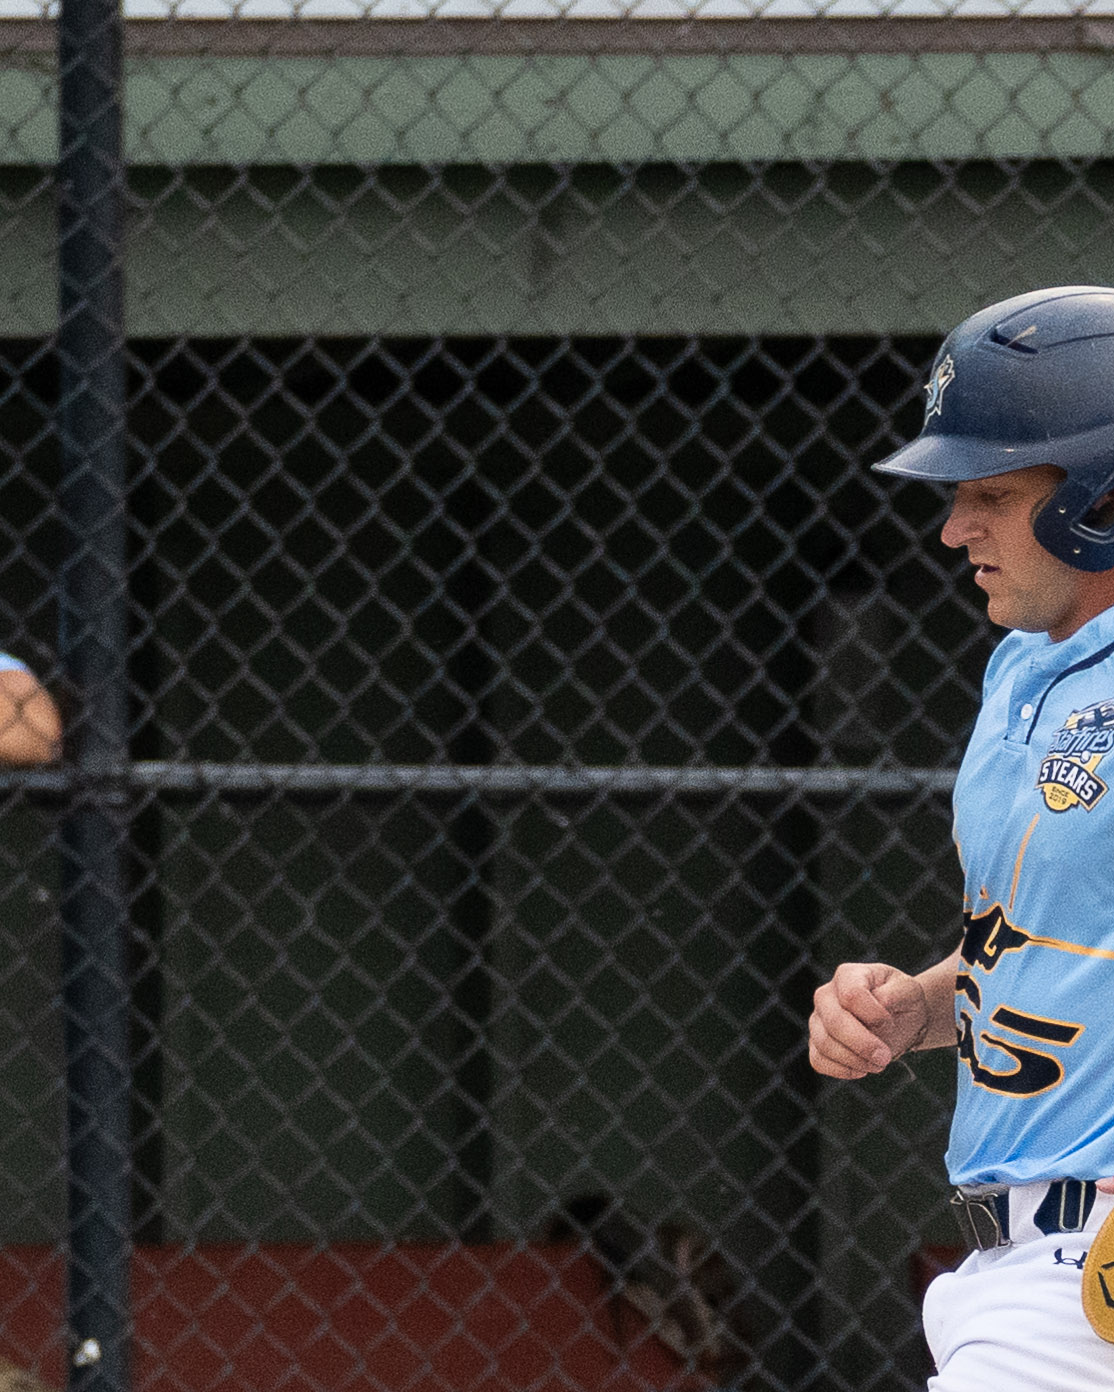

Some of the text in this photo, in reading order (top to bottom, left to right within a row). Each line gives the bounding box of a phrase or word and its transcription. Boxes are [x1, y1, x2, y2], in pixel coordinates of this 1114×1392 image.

[1040, 760, 1098, 801] 5 YEARS
[1048, 792, 1067, 805] 2019
